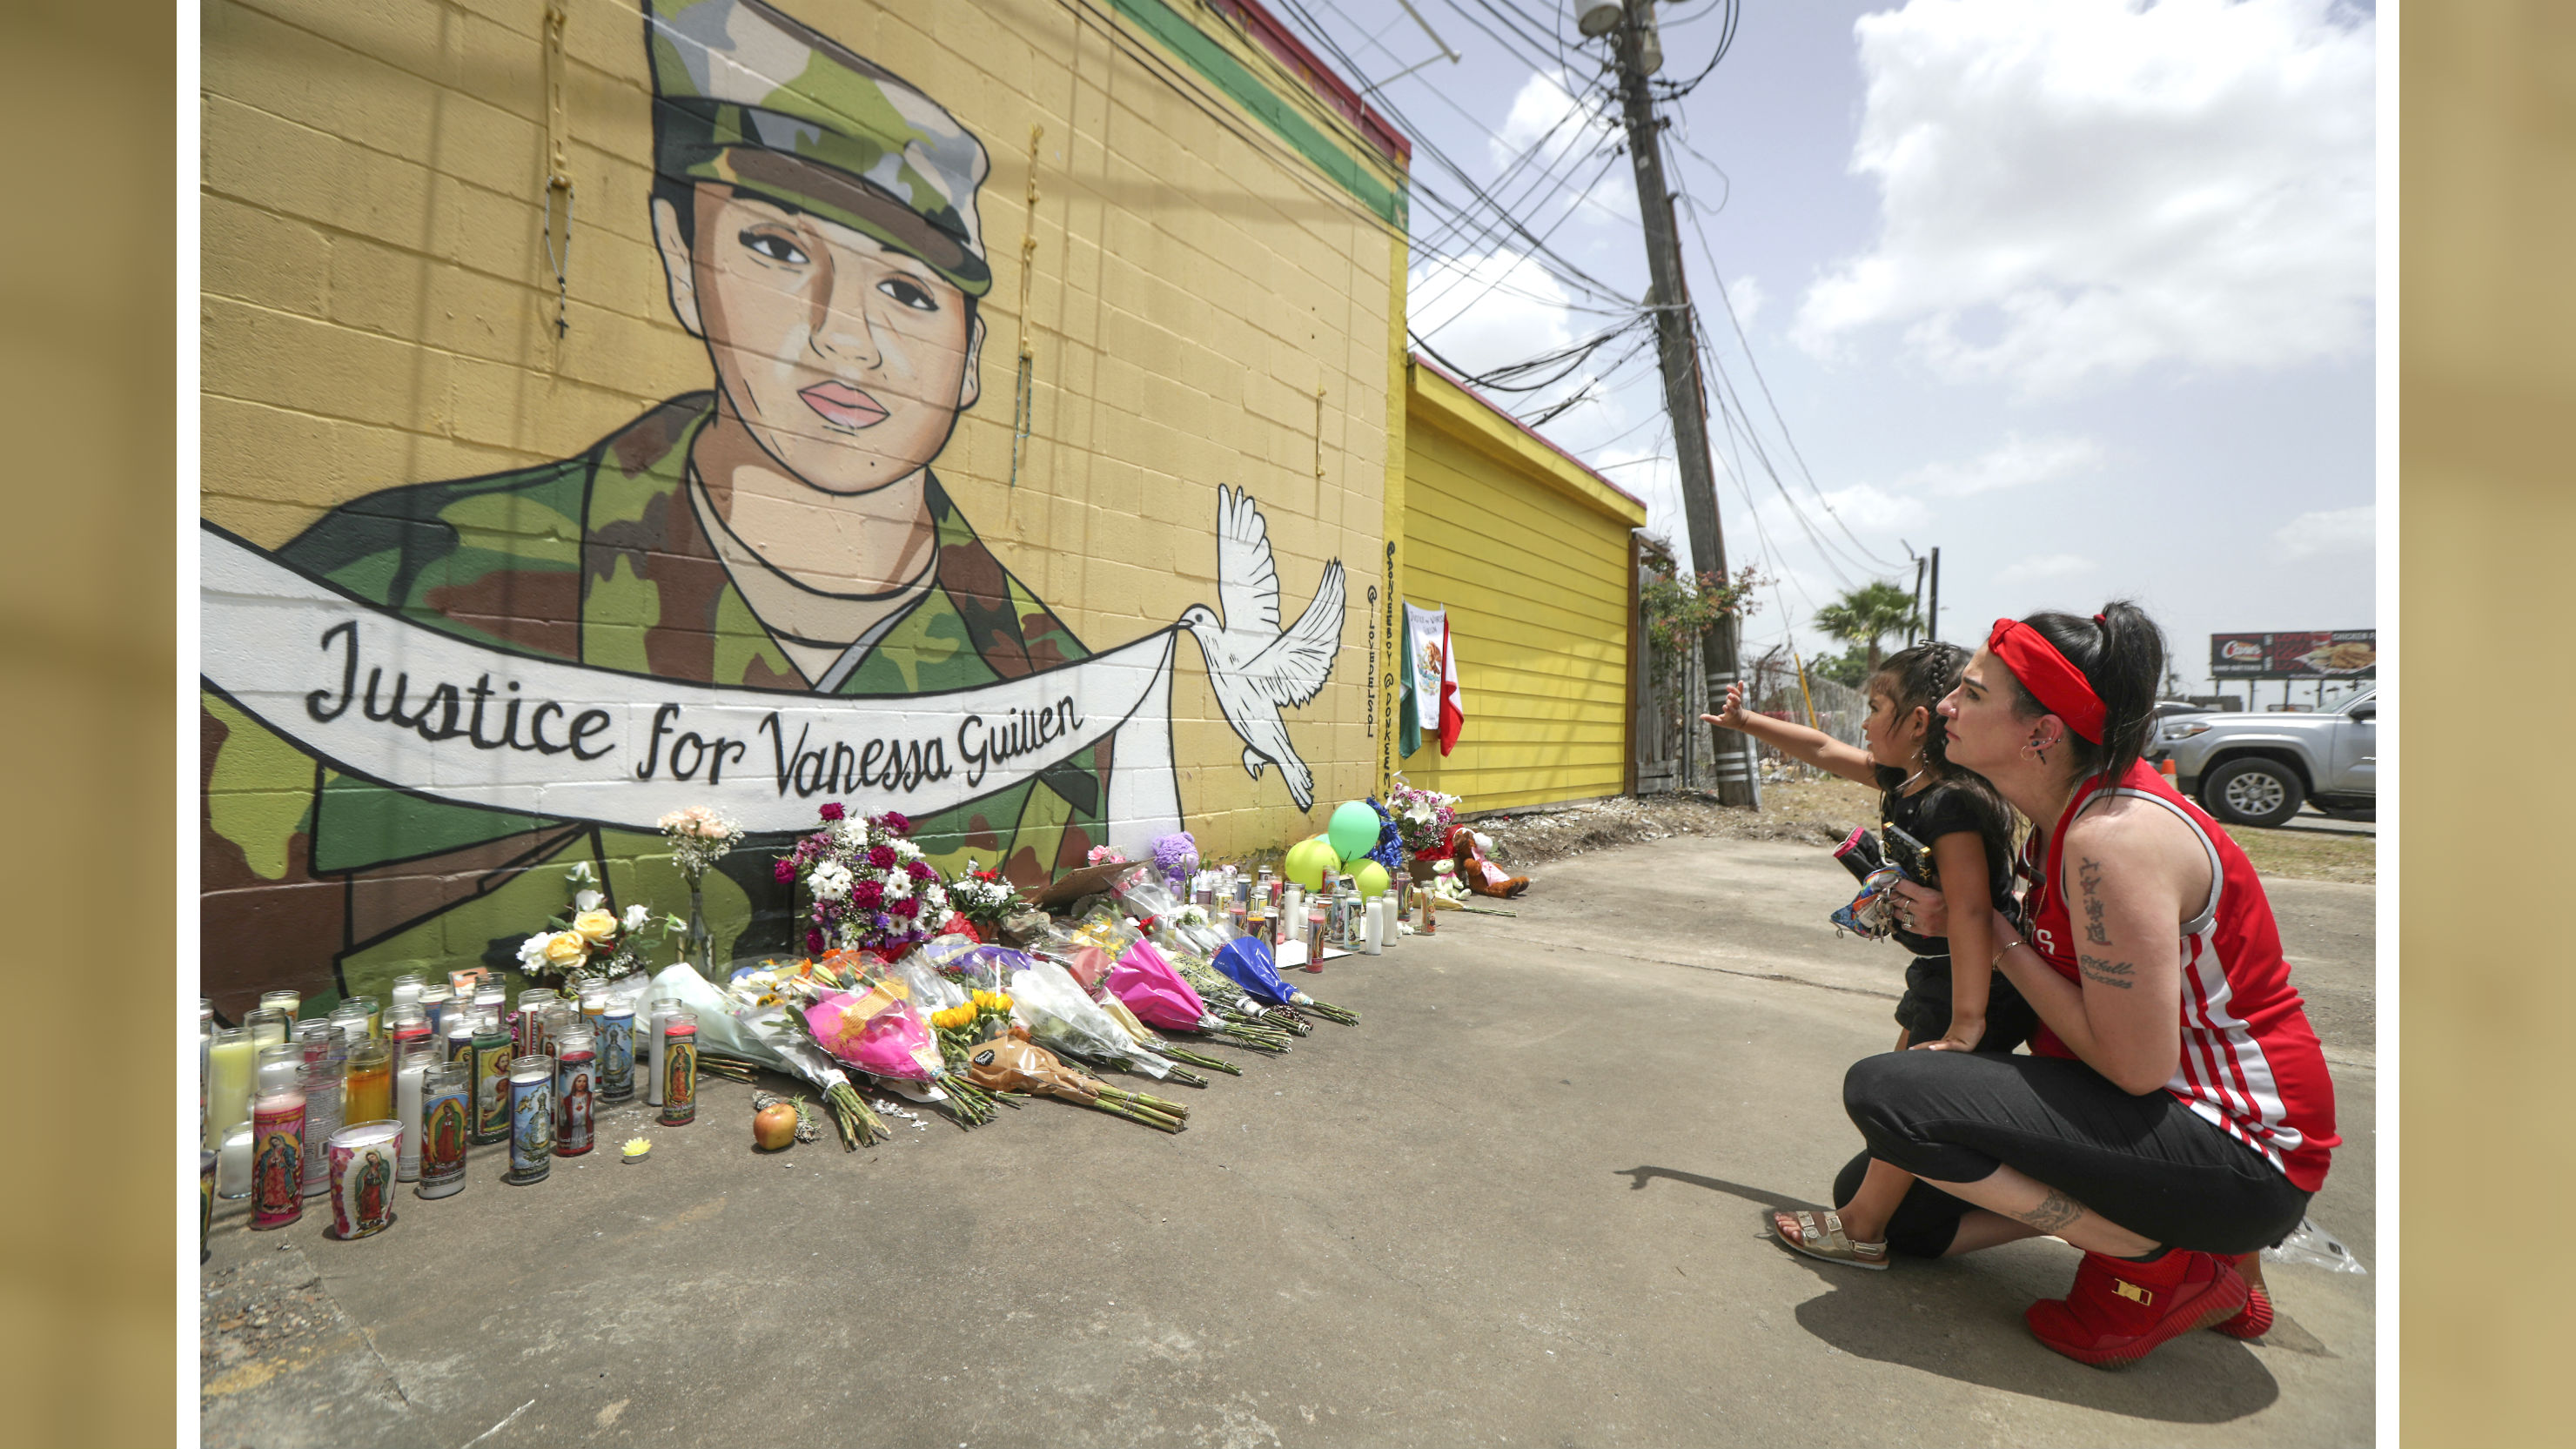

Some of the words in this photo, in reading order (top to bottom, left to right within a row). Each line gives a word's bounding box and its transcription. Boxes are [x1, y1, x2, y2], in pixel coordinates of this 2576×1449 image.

[306, 620, 615, 761] Justice
[636, 702, 746, 785] for
[759, 711, 954, 799] Vanessa
[957, 694, 1084, 788] Guillen
